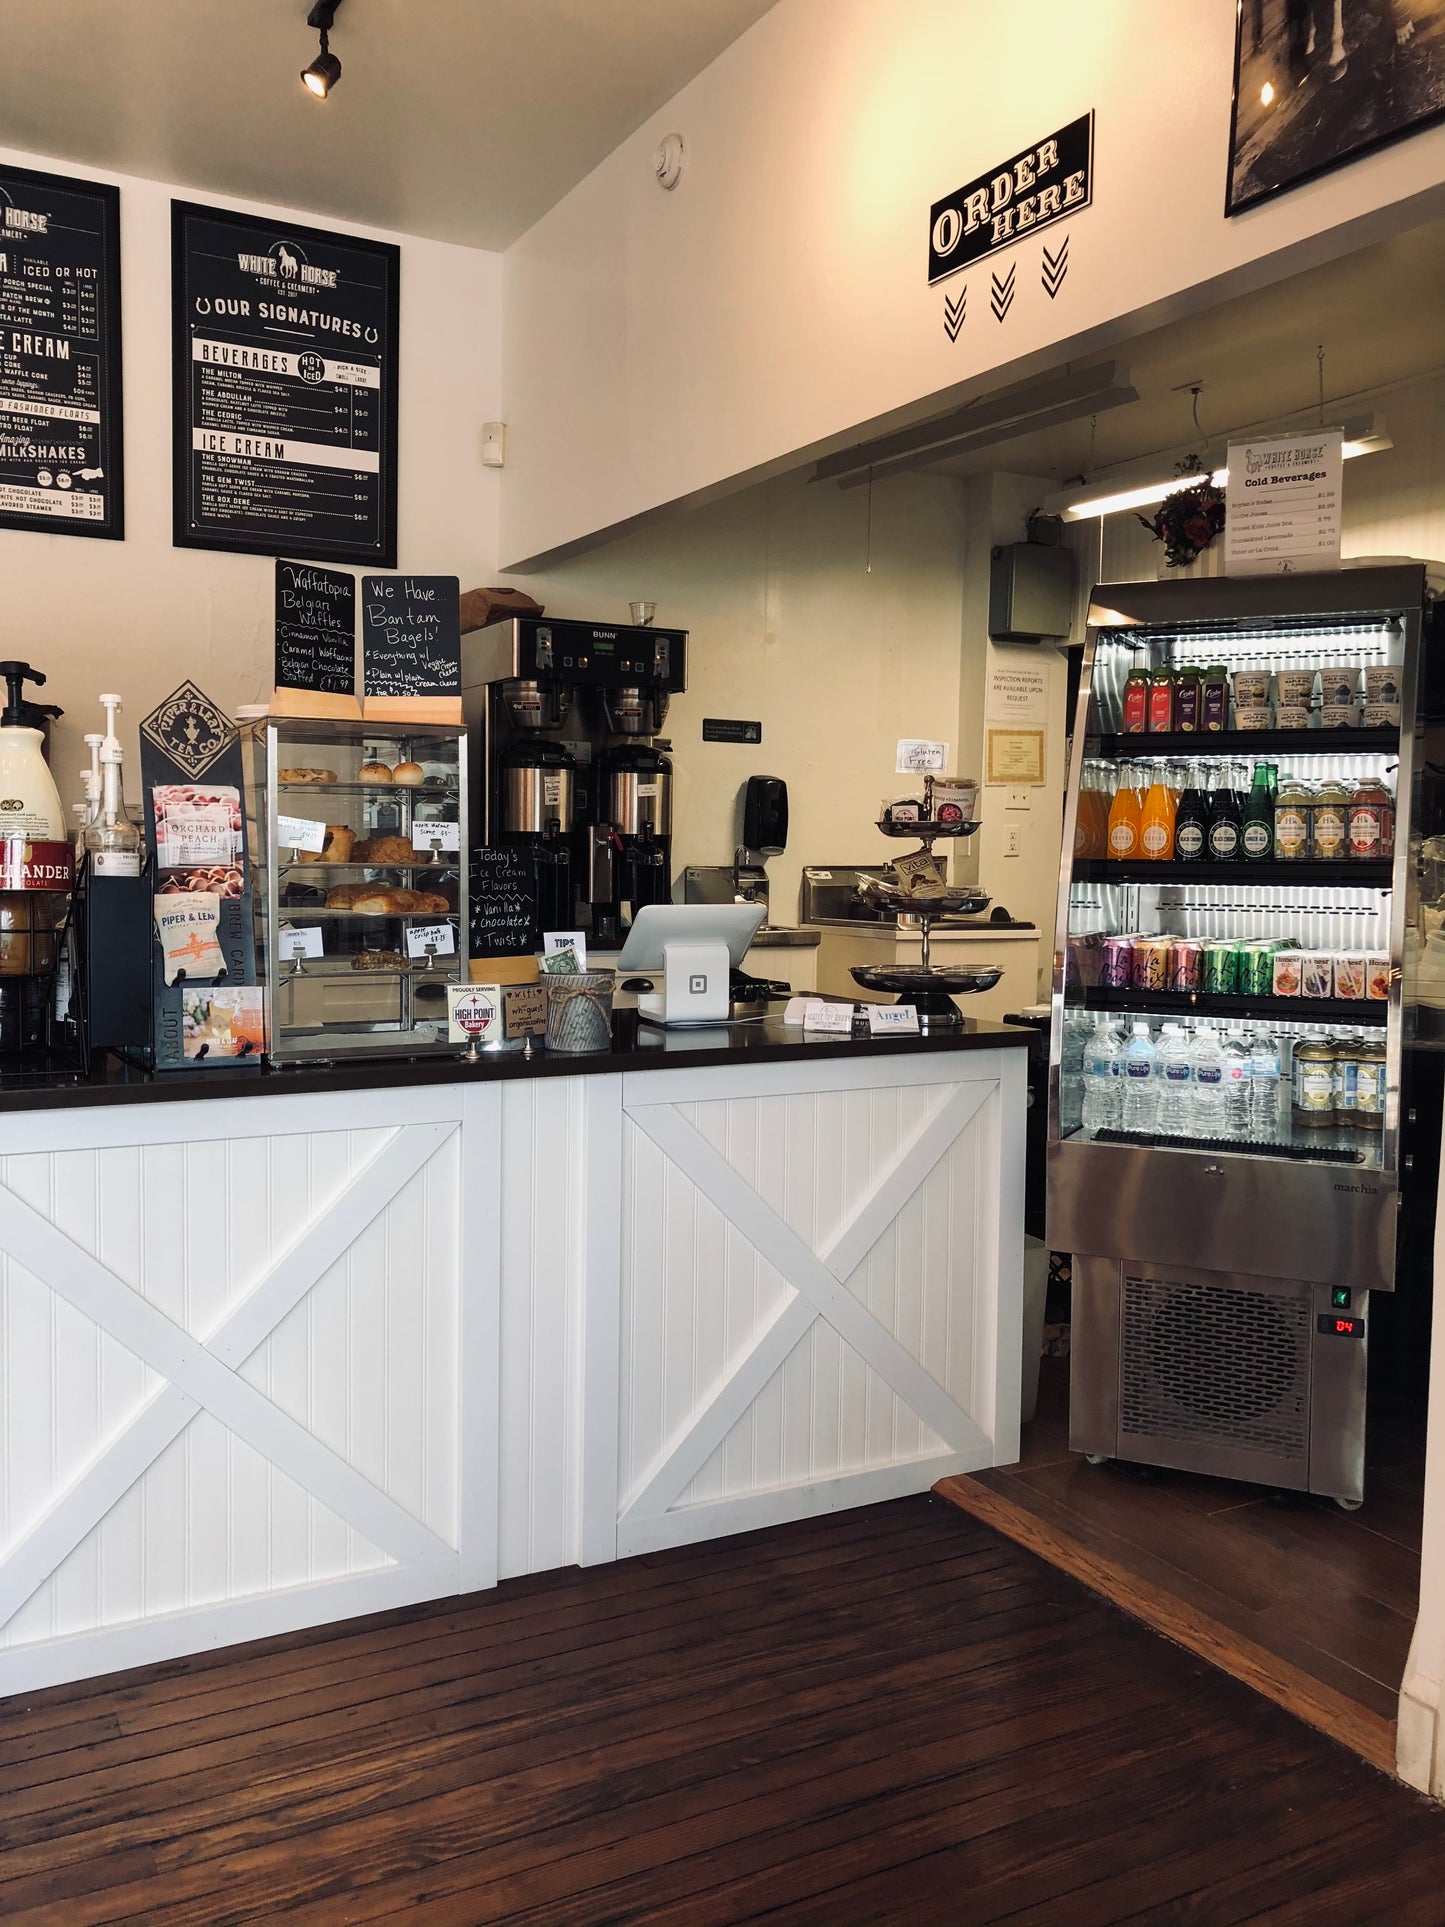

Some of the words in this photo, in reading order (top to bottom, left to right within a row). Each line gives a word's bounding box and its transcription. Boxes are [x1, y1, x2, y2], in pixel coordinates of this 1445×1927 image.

[932, 138, 1059, 258] ORDER
[990, 170, 1085, 245] HERE
[5, 206, 48, 234] HORSE
[24, 265, 50, 276] ICED
[56, 267, 70, 277] OR
[76, 268, 98, 278] HOT
[238, 253, 277, 278] WHITE
[300, 264, 337, 289] HORSE
[4, 278, 25, 287] PORCH
[27, 282, 53, 292] SPECIAL
[260, 277, 280, 288] COFFEE
[2, 292, 23, 300] PATCH
[25, 296, 44, 304] BREW
[32, 308, 55, 318] MONTH
[214, 298, 250, 316] OUR
[258, 302, 362, 338] SIGNATURES
[14, 315, 32, 325] LATTE
[12, 332, 70, 360] CREAM
[203, 344, 288, 372] BEVERAGES
[302, 356, 321, 368] HOT
[4, 368, 28, 377] WAFFLE
[218, 370, 242, 379] MILTON
[304, 369, 321, 380] ICED
[218, 391, 252, 402] ABDULLAH
[8, 401, 55, 415] FASHIONED
[59, 408, 90, 420] FLOATS
[218, 411, 242, 420] CEDRIC
[14, 424, 34, 432] FLOAT
[30, 418, 50, 427] FLOAT
[203, 434, 226, 452] ICE
[236, 438, 284, 459] CREAM
[218, 455, 252, 465] SNOWMAN
[1263, 450, 1292, 465] WHITE
[1294, 446, 1324, 460] HORSE
[235, 478, 255, 487] TWIST
[1245, 477, 1268, 487] Cold
[1271, 471, 1327, 485] Beverages
[8, 488, 42, 497] CHOCOLATE
[30, 497, 62, 506] CHOCOLATE
[234, 498, 251, 506] DENE
[283, 566, 351, 600] Waffatopia
[371, 581, 394, 598] We
[282, 590, 330, 615] Belgian
[300, 609, 341, 628] Waffles
[366, 604, 440, 627] Bantam
[280, 626, 319, 642] Cinnamon
[322, 630, 348, 646] Vanilla
[384, 626, 440, 648] Bagels!
[593, 631, 616, 639] BUNN
[282, 641, 315, 658] Caramel
[372, 650, 417, 666] Everything
[281, 657, 309, 674] Belgian
[311, 659, 349, 675] Chocolate
[283, 668, 314, 684] Stuffed
[371, 668, 392, 679] Plain
[994, 675, 1021, 683] INSPECTION
[1022, 677, 1043, 685] REPORTS
[1003, 684, 1028, 692] AVAILABLE
[161, 703, 188, 731] PIPER
[189, 703, 198, 715] &
[170, 736, 193, 755] TEA
[909, 755, 932, 764] Free
[172, 825, 225, 833] ORCHARD
[181, 834, 217, 843] PEACH
[474, 848, 518, 868] Today's
[468, 863, 489, 878] Ice
[496, 865, 527, 878] Cream
[902, 858, 929, 872] vita
[482, 880, 518, 891] Flavors
[484, 902, 514, 915] Vanilla
[162, 914, 185, 926] PIPER
[189, 913, 195, 921] &
[227, 904, 242, 940] BREW
[480, 916, 522, 928] Chocolate
[484, 931, 516, 947] Twist
[554, 938, 575, 948] TIPS
[454, 1009, 472, 1020] HIGH
[474, 1007, 495, 1019] POINT
[512, 1004, 543, 1016] wh-guest
[464, 1020, 485, 1030] Bakery
[163, 1008, 179, 1064] ABOUT
[1334, 1183, 1378, 1195] marchia
[1336, 1320, 1353, 1332] 04
